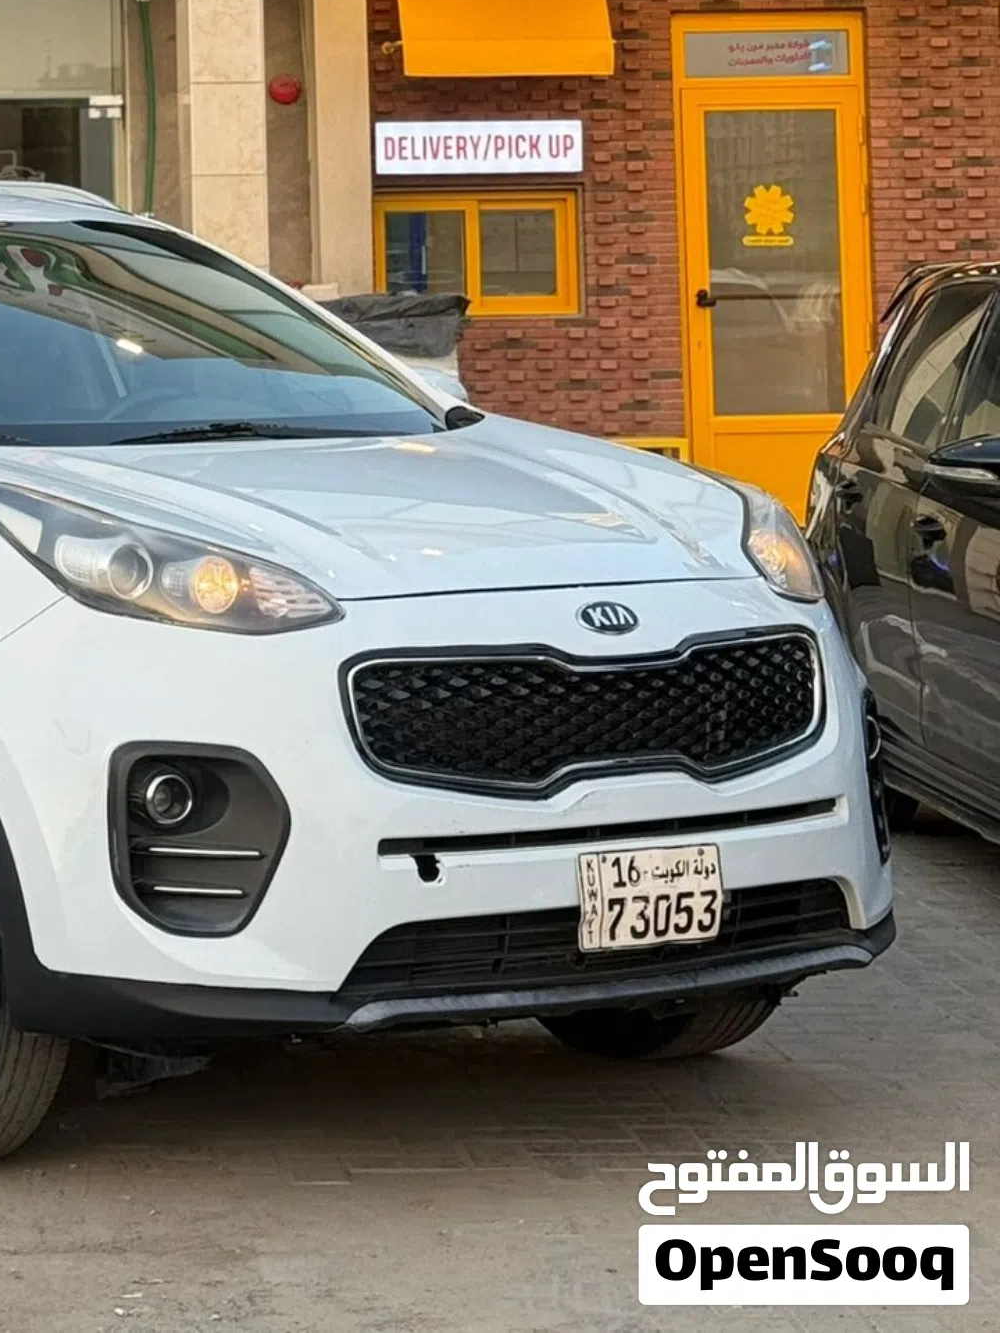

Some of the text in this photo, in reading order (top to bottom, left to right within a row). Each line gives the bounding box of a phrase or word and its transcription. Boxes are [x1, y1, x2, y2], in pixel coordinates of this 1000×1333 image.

[383, 133, 575, 162] DELIVERY/PICK UP
[585, 604, 635, 627] KIA
[610, 855, 641, 888] 16
[651, 859, 690, 883] الكويت
[693, 857, 716, 880] دولة
[607, 889, 718, 942] 73053
